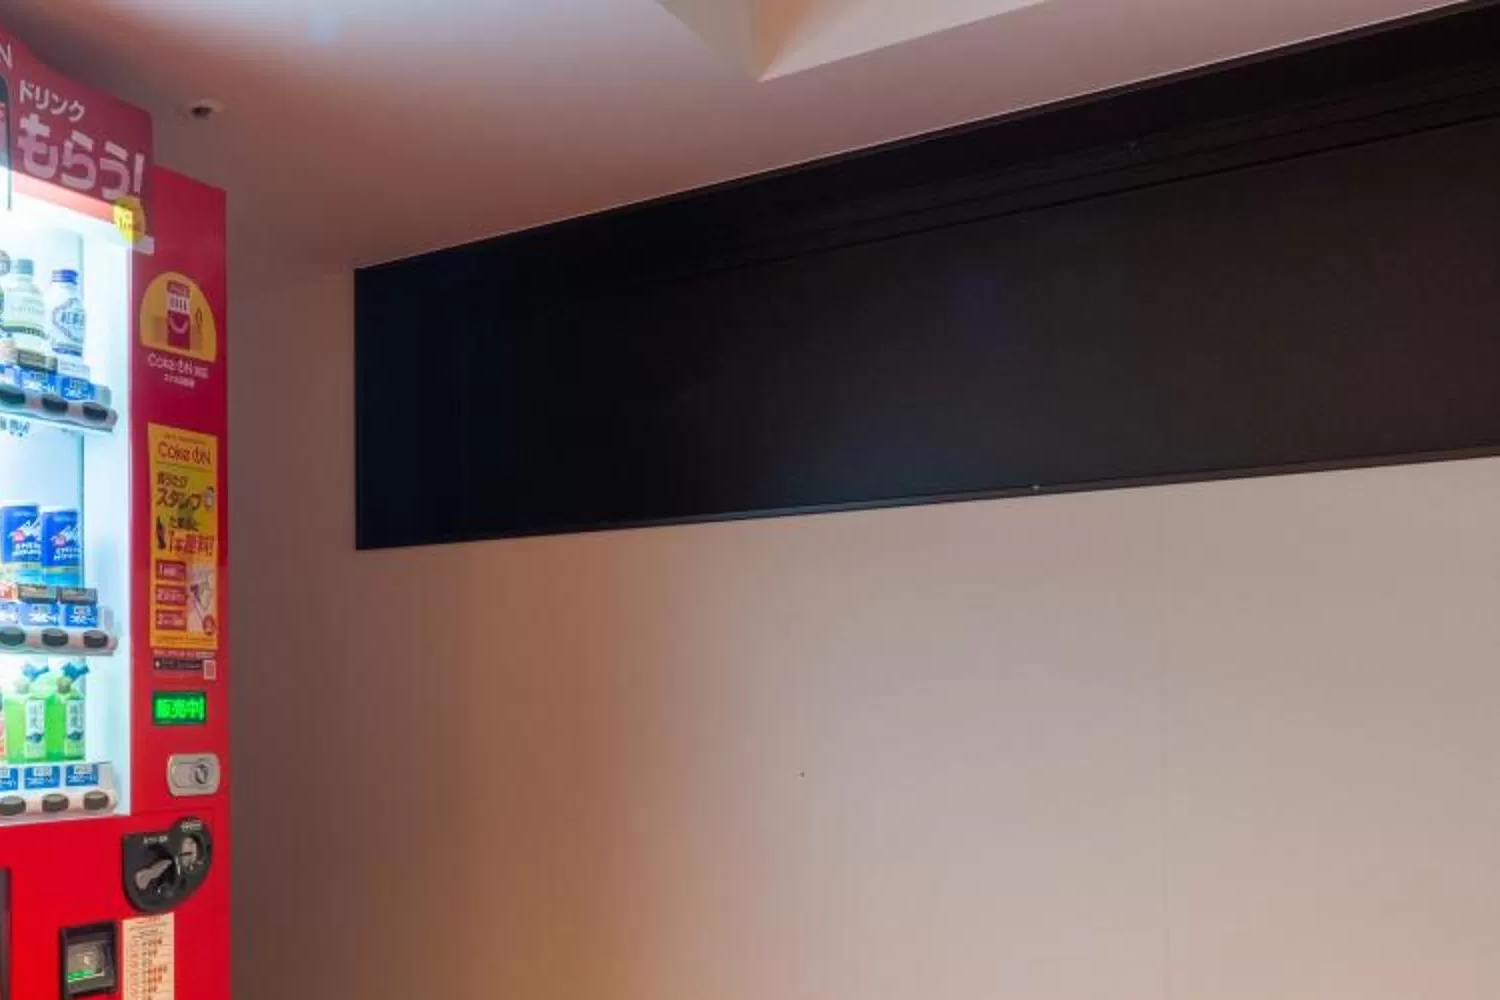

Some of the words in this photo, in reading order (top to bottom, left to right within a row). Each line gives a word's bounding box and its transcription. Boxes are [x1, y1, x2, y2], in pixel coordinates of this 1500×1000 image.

[18, 80, 86, 122] ドリンク
[18, 115, 146, 202] もらう!
